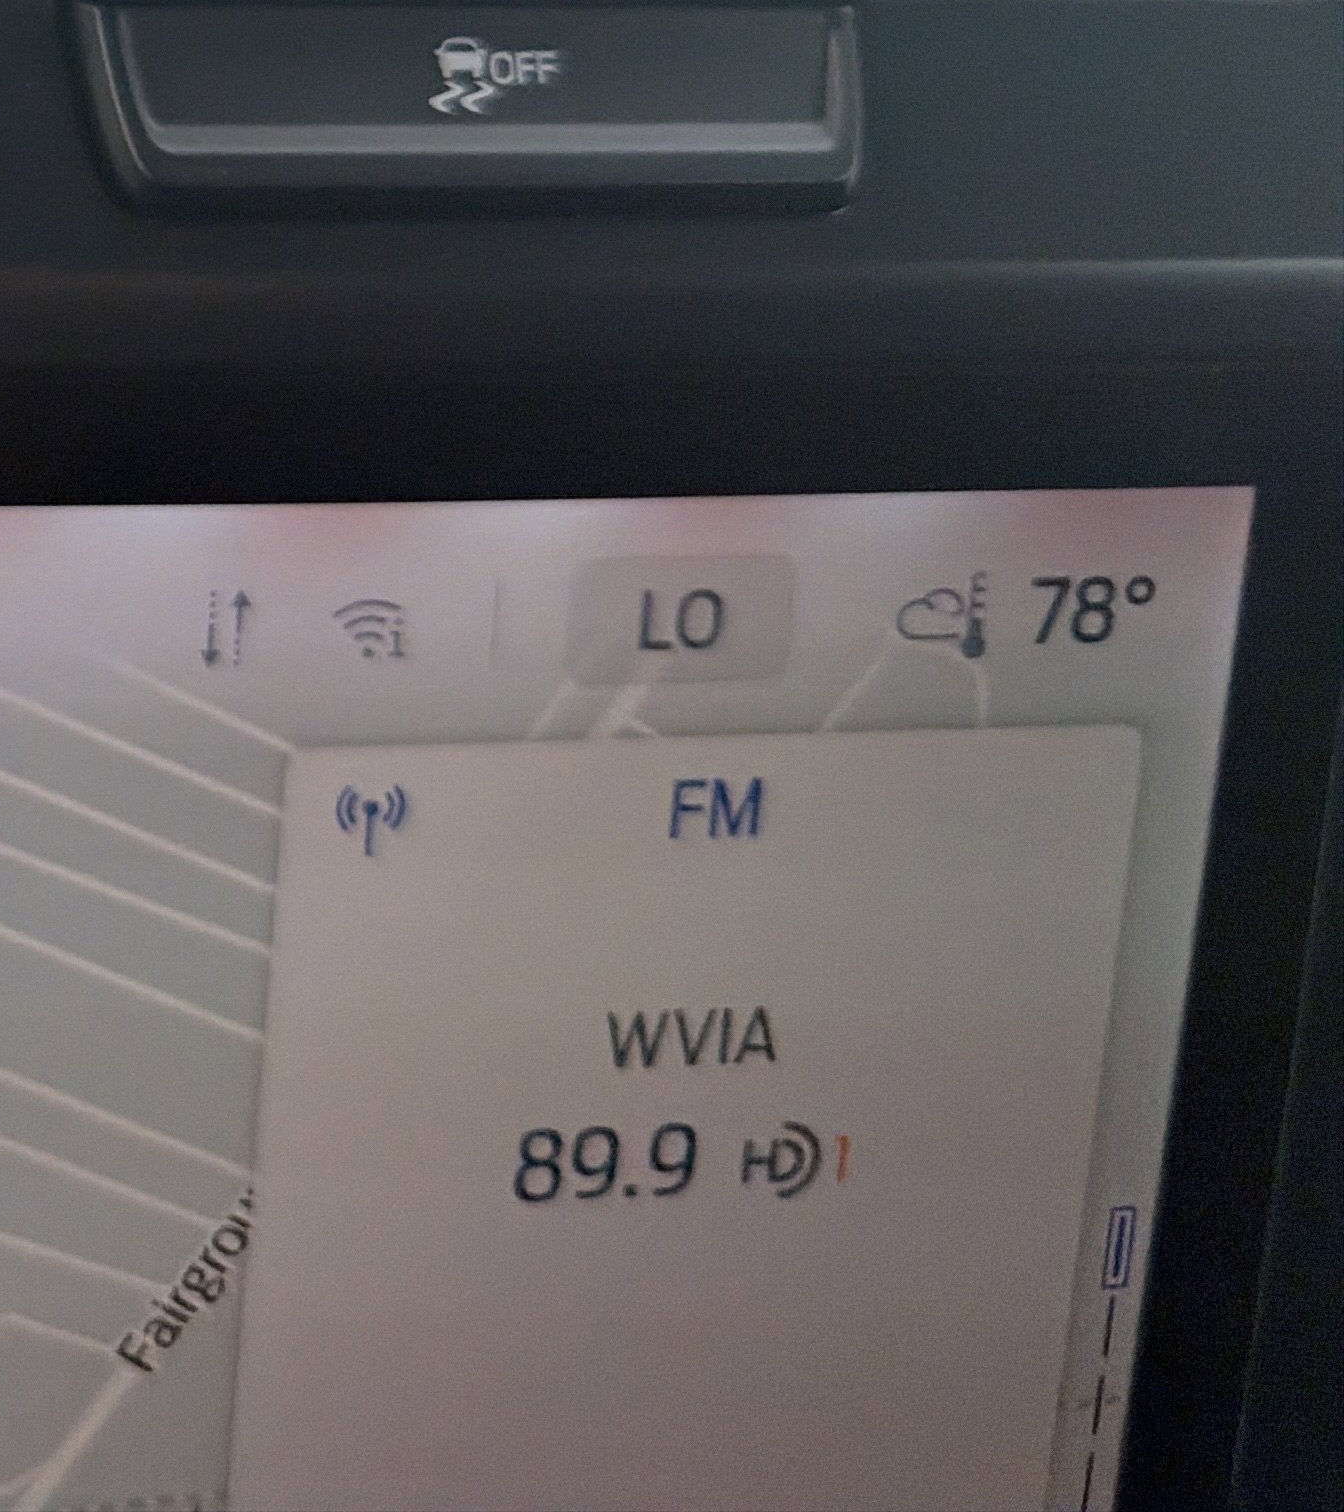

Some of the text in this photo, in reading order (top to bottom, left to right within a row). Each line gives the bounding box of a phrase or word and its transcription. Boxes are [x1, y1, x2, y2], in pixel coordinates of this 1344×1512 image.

[488, 48, 561, 86] OFF
[638, 589, 725, 652] LO
[1031, 574, 1157, 646] 78°
[668, 777, 766, 841] FM
[607, 1006, 779, 1071] WVIA
[512, 1122, 700, 1205] 89.9
